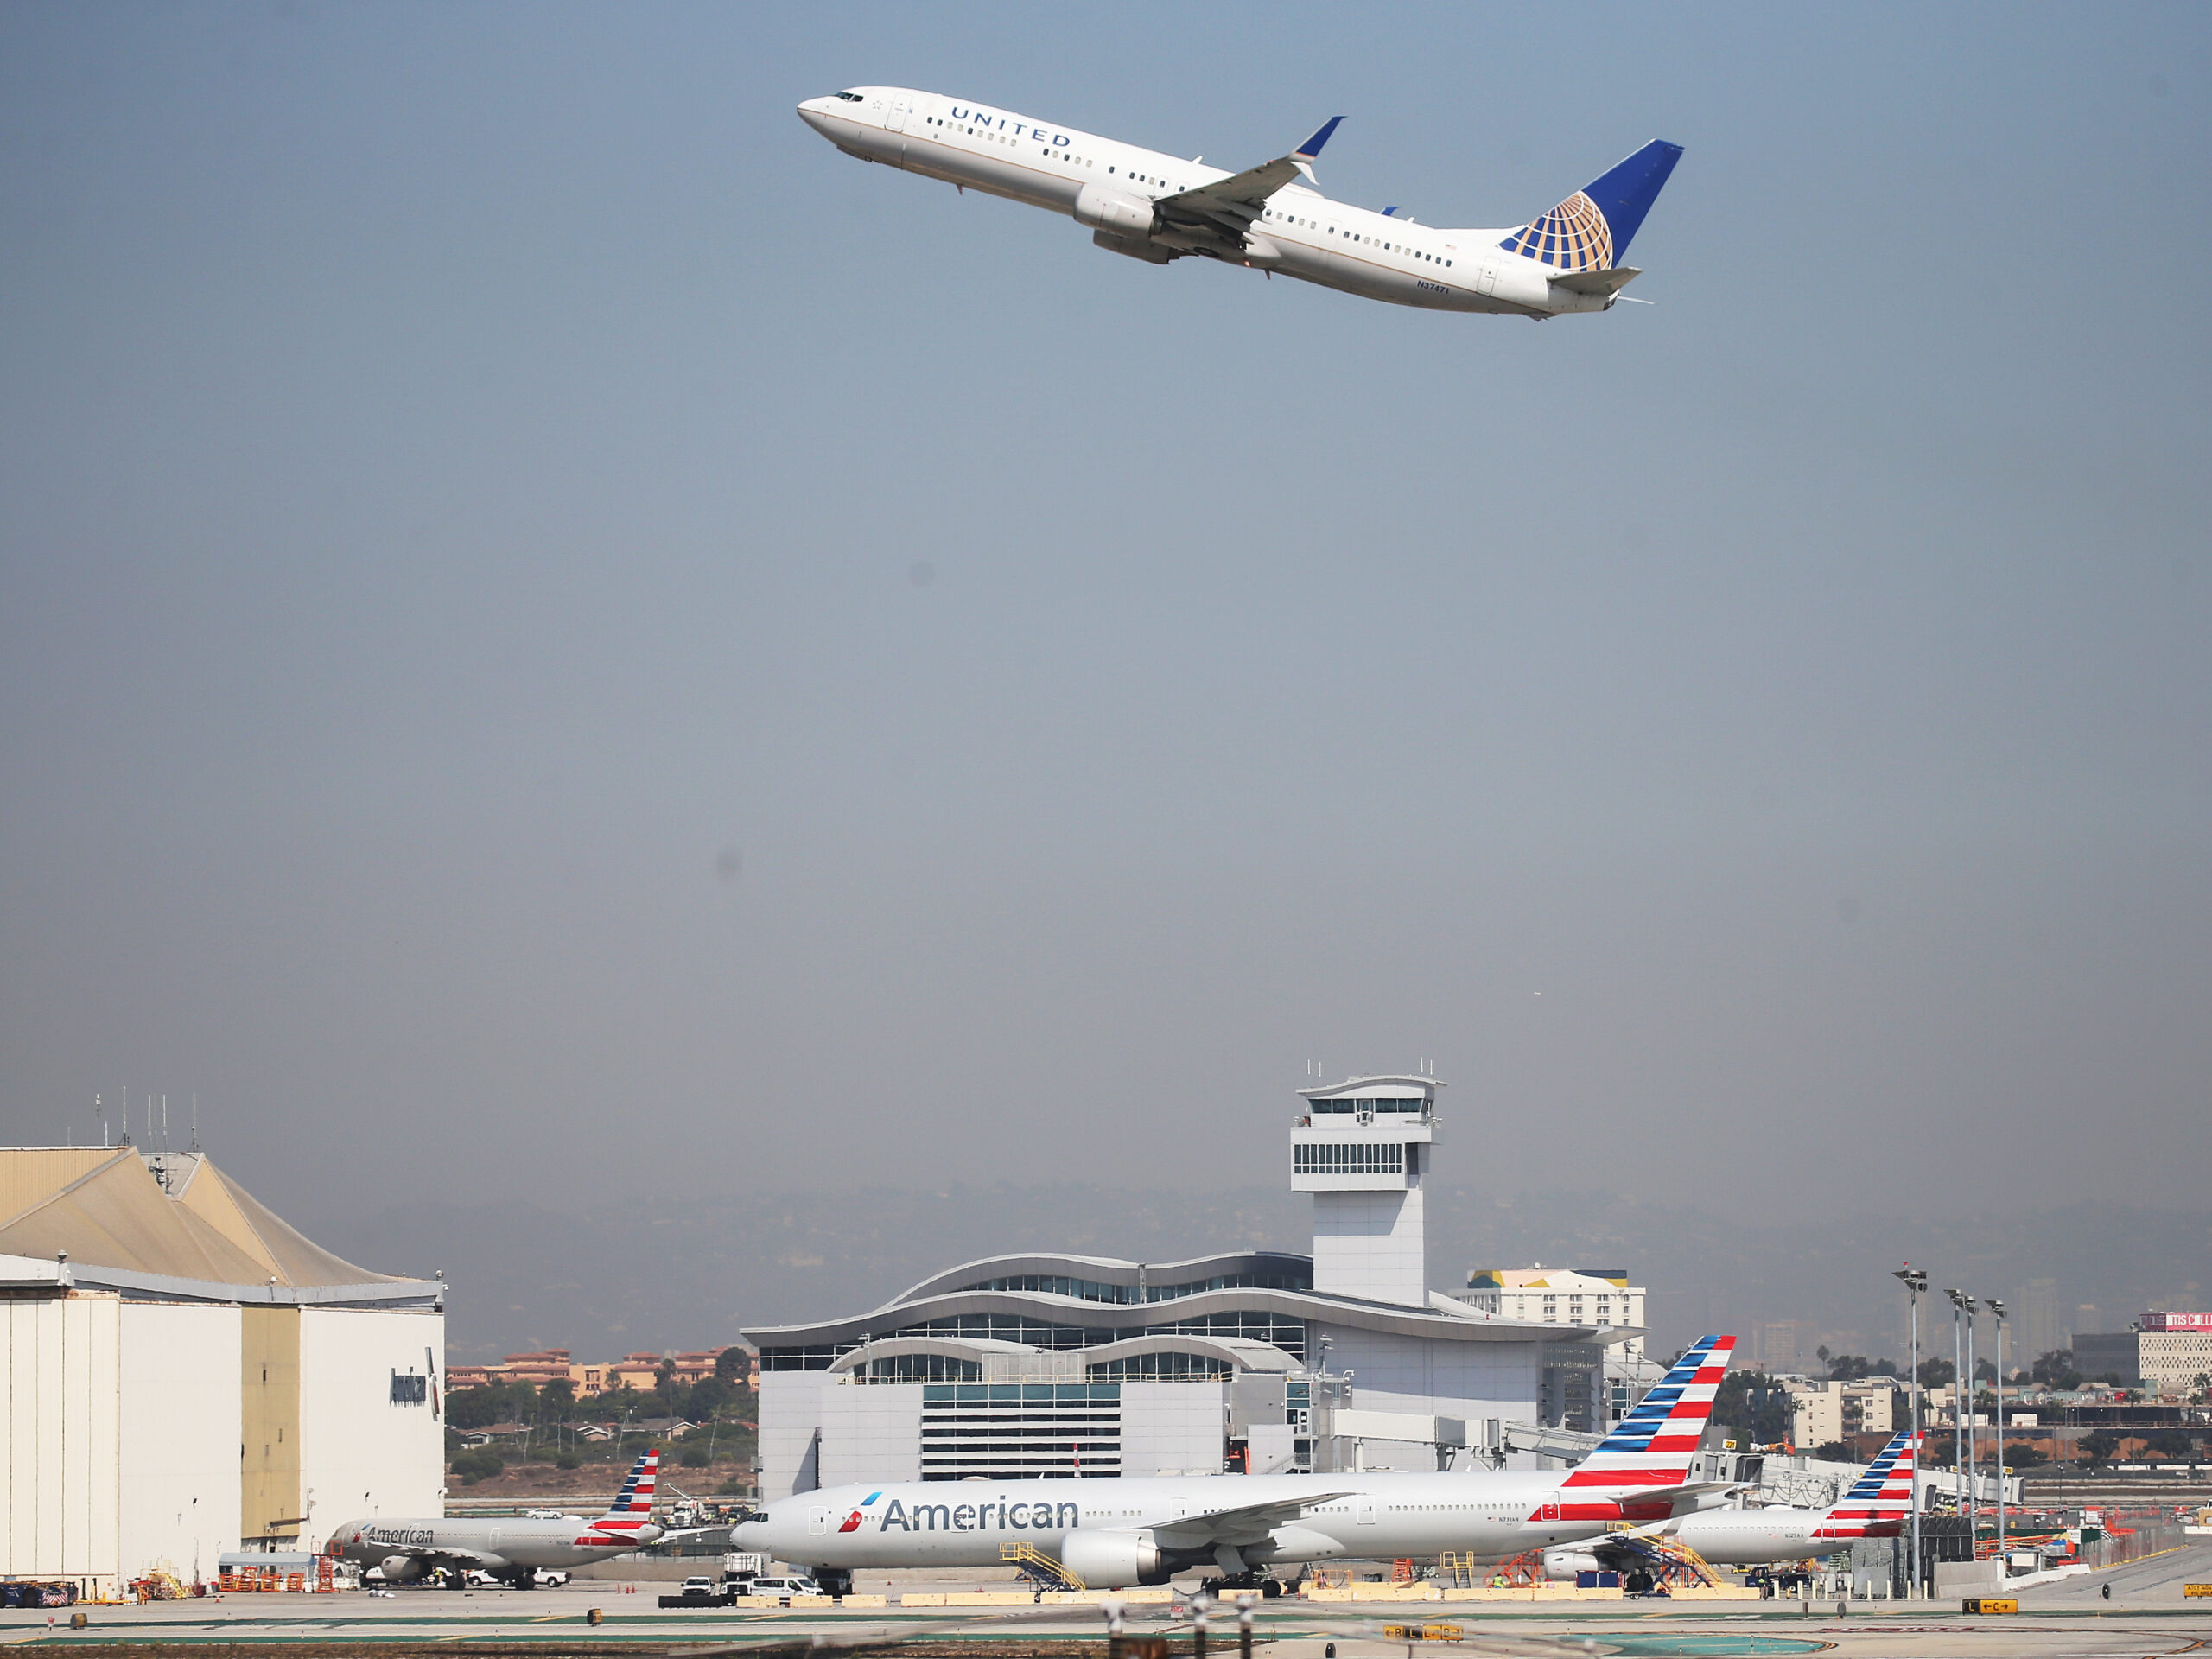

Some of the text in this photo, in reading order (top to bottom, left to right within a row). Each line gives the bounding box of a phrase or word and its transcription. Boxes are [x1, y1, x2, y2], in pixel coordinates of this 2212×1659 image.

[951, 106, 1071, 147] UNITED
[1417, 280, 1449, 295] N37471
[880, 1495, 1078, 1532] American
[367, 1526, 434, 1544] American
[1969, 1602, 1999, 1611] L C
